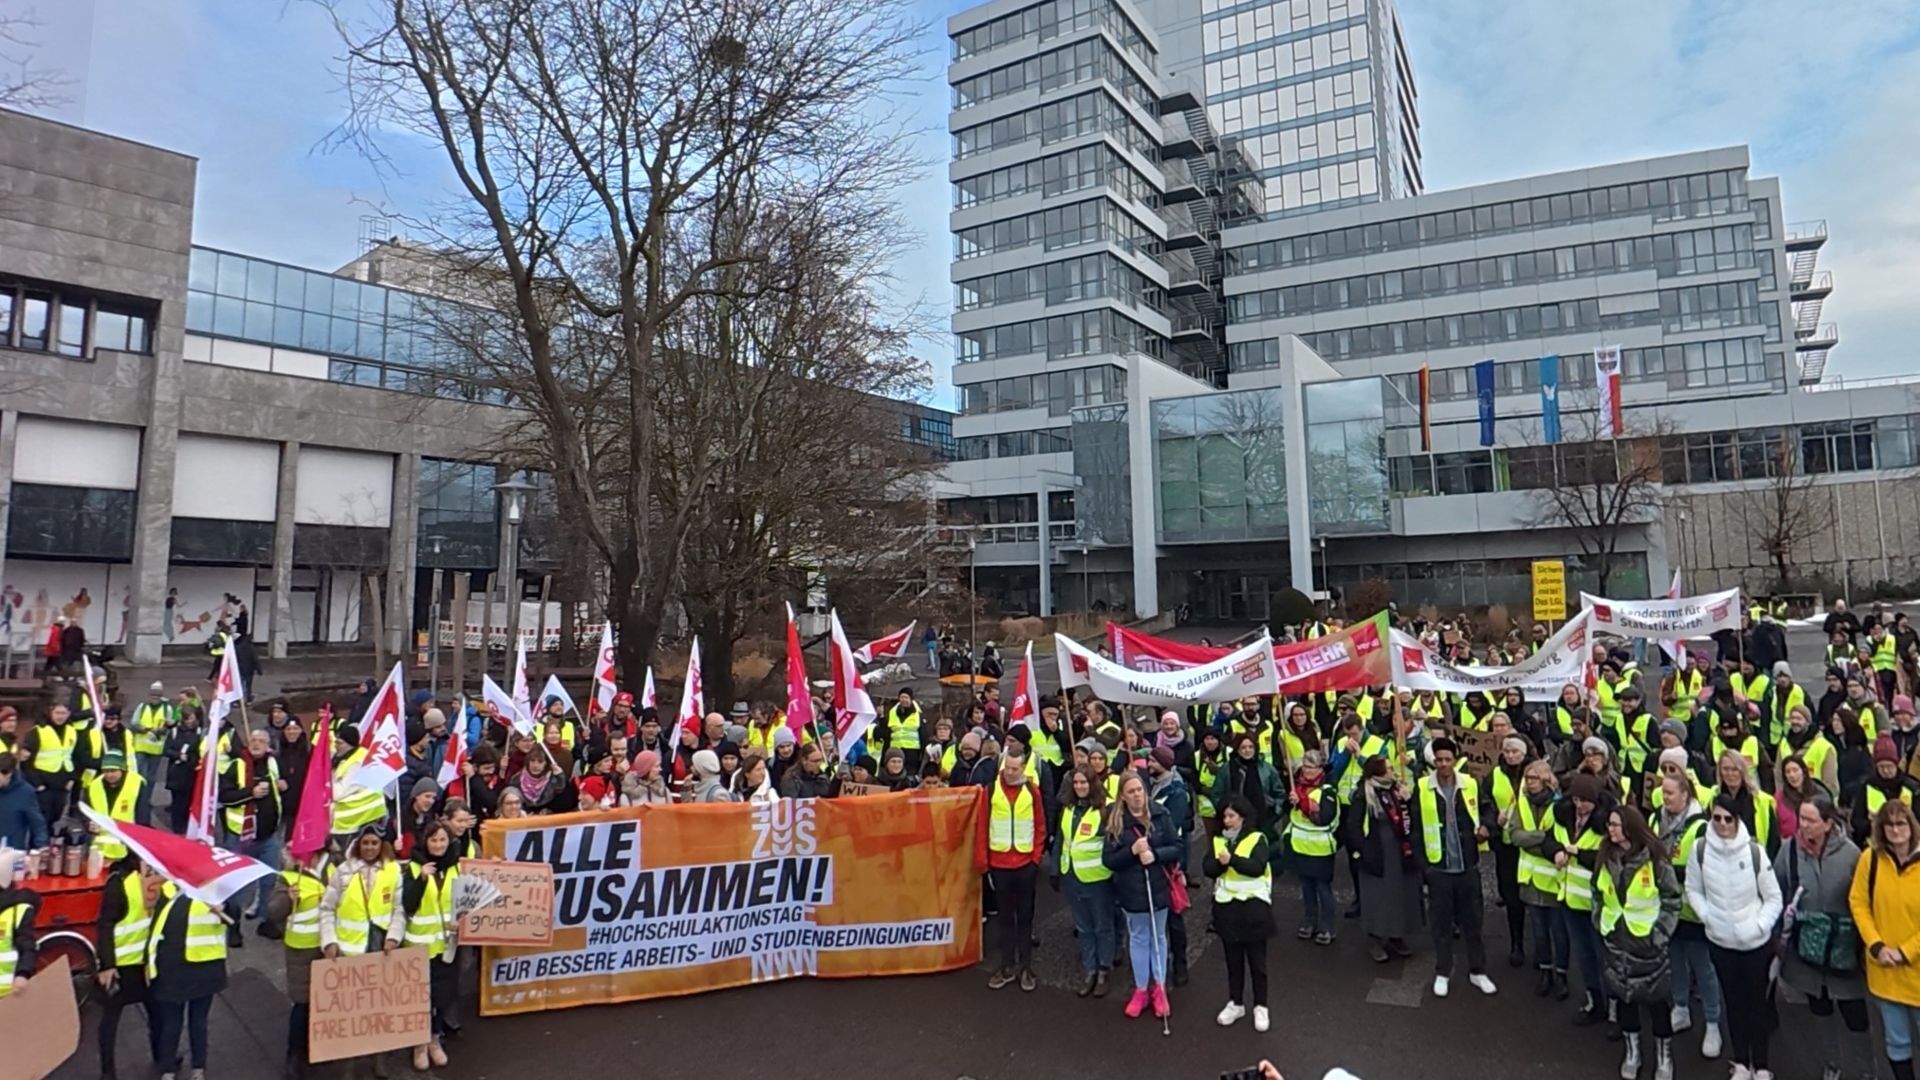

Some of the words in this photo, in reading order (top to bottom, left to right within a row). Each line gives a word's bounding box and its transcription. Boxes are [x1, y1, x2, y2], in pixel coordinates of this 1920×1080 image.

[1177, 665, 1230, 690] Bauamt
[844, 784, 868, 796] WIR
[515, 822, 637, 874] ALLE
[554, 857, 830, 926] USAMMEN!
[588, 905, 803, 945] #HOCHSCHULAKTIONSTAG
[495, 960, 531, 983] FÜR
[535, 951, 618, 977] BESSERE
[621, 943, 706, 969] ARBEITS-
[711, 936, 747, 959] UND
[751, 922, 952, 952] STUDIENBEDINGUNGEN!
[323, 963, 377, 991] OHNE
[382, 957, 421, 986] UNS
